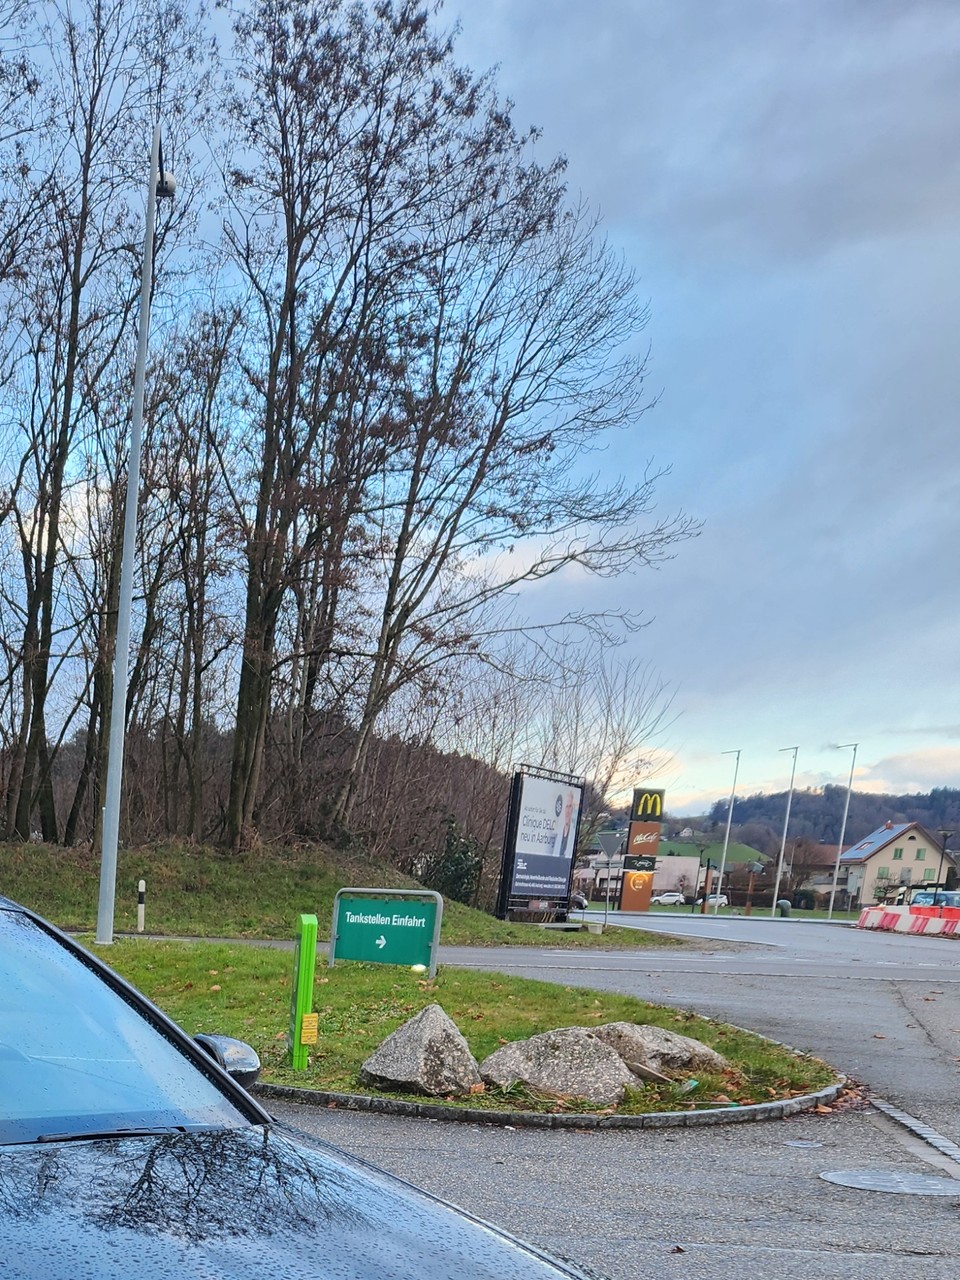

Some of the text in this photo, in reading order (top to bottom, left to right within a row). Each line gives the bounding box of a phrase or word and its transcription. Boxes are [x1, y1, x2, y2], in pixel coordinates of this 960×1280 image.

[522, 814, 542, 831] Clinique
[521, 832, 530, 842] neu
[536, 833, 556, 848] Aarburg
[345, 911, 426, 927] Tankstellen Einfahrt
